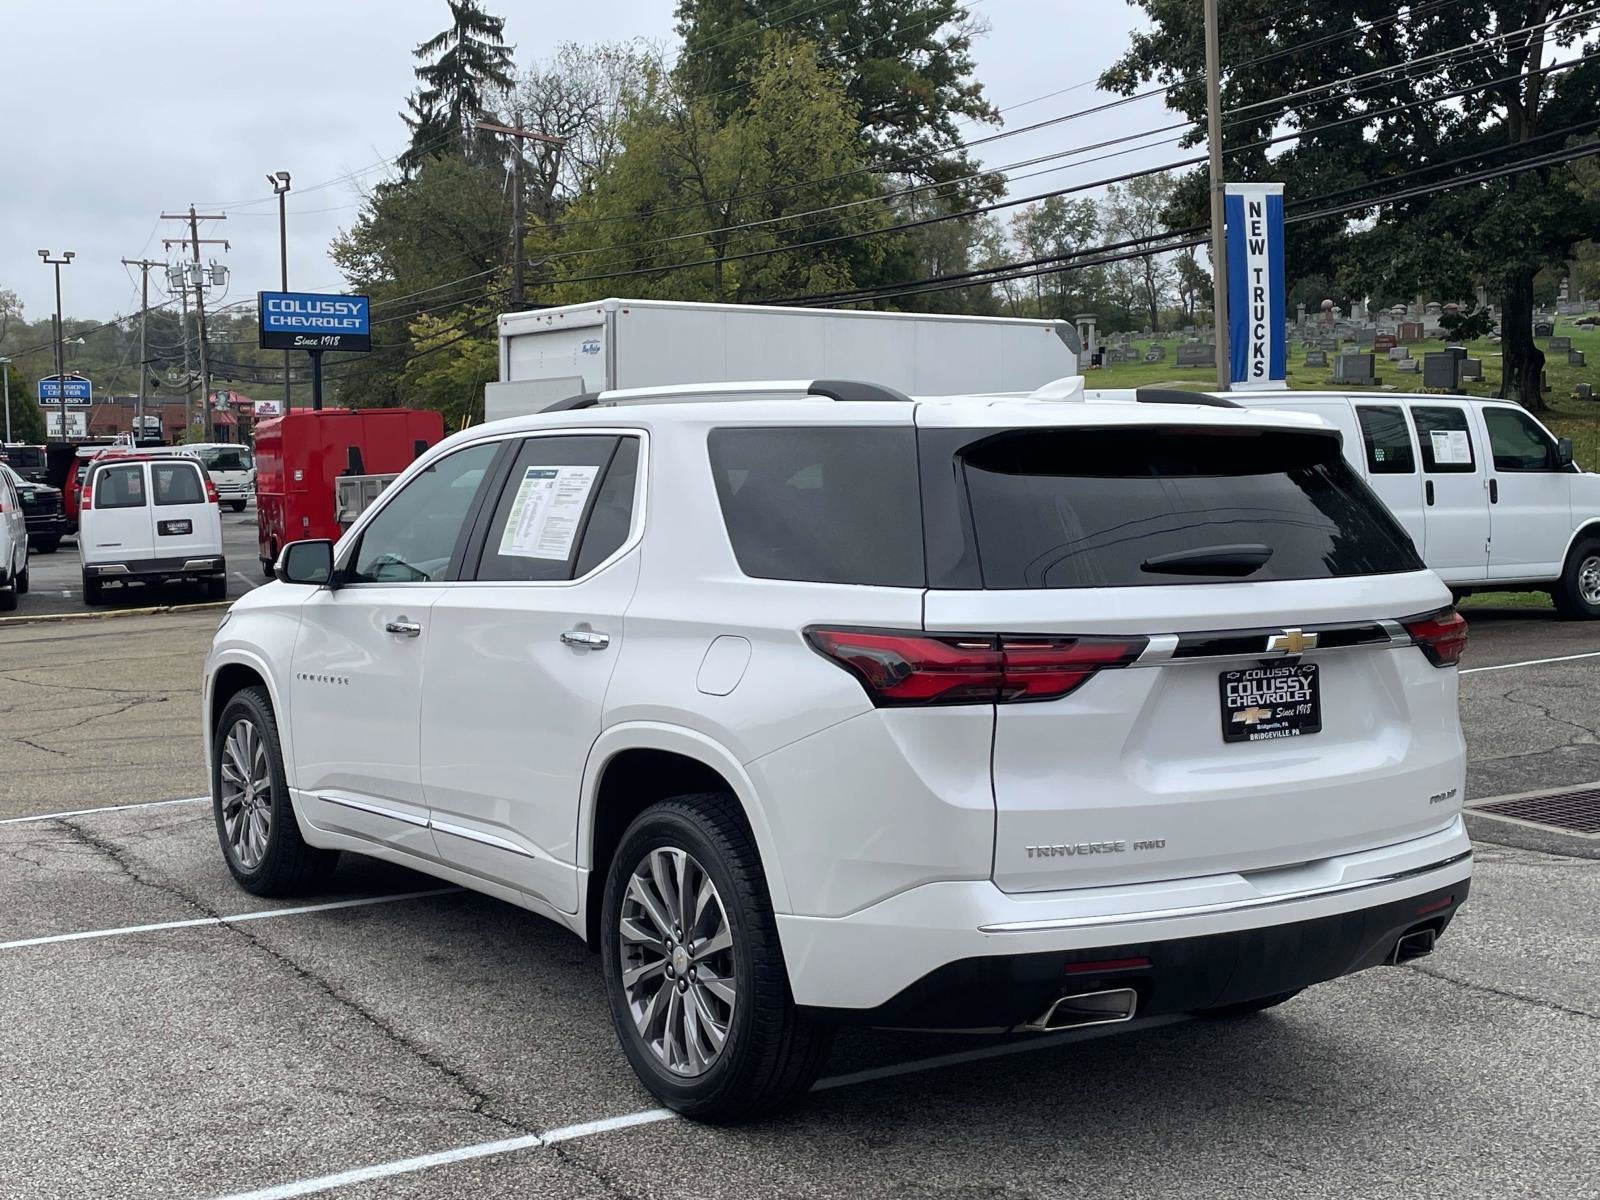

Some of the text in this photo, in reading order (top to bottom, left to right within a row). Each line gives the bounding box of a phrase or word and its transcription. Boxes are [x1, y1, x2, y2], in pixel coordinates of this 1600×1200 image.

[1249, 201, 1265, 377] NEW TRUCKS
[268, 299, 362, 315] COLUSSY
[270, 315, 362, 328] CHEVROLET
[293, 336, 341, 346] Since 1918
[1245, 666, 1298, 679] COLUSSY
[1226, 675, 1313, 697] COLUSSY
[1227, 689, 1312, 707] CHEVROLET
[1276, 704, 1312, 717] Since 1918
[1291, 728, 1300, 736] PA
[1024, 839, 1166, 858] TRAVERSE AWD
